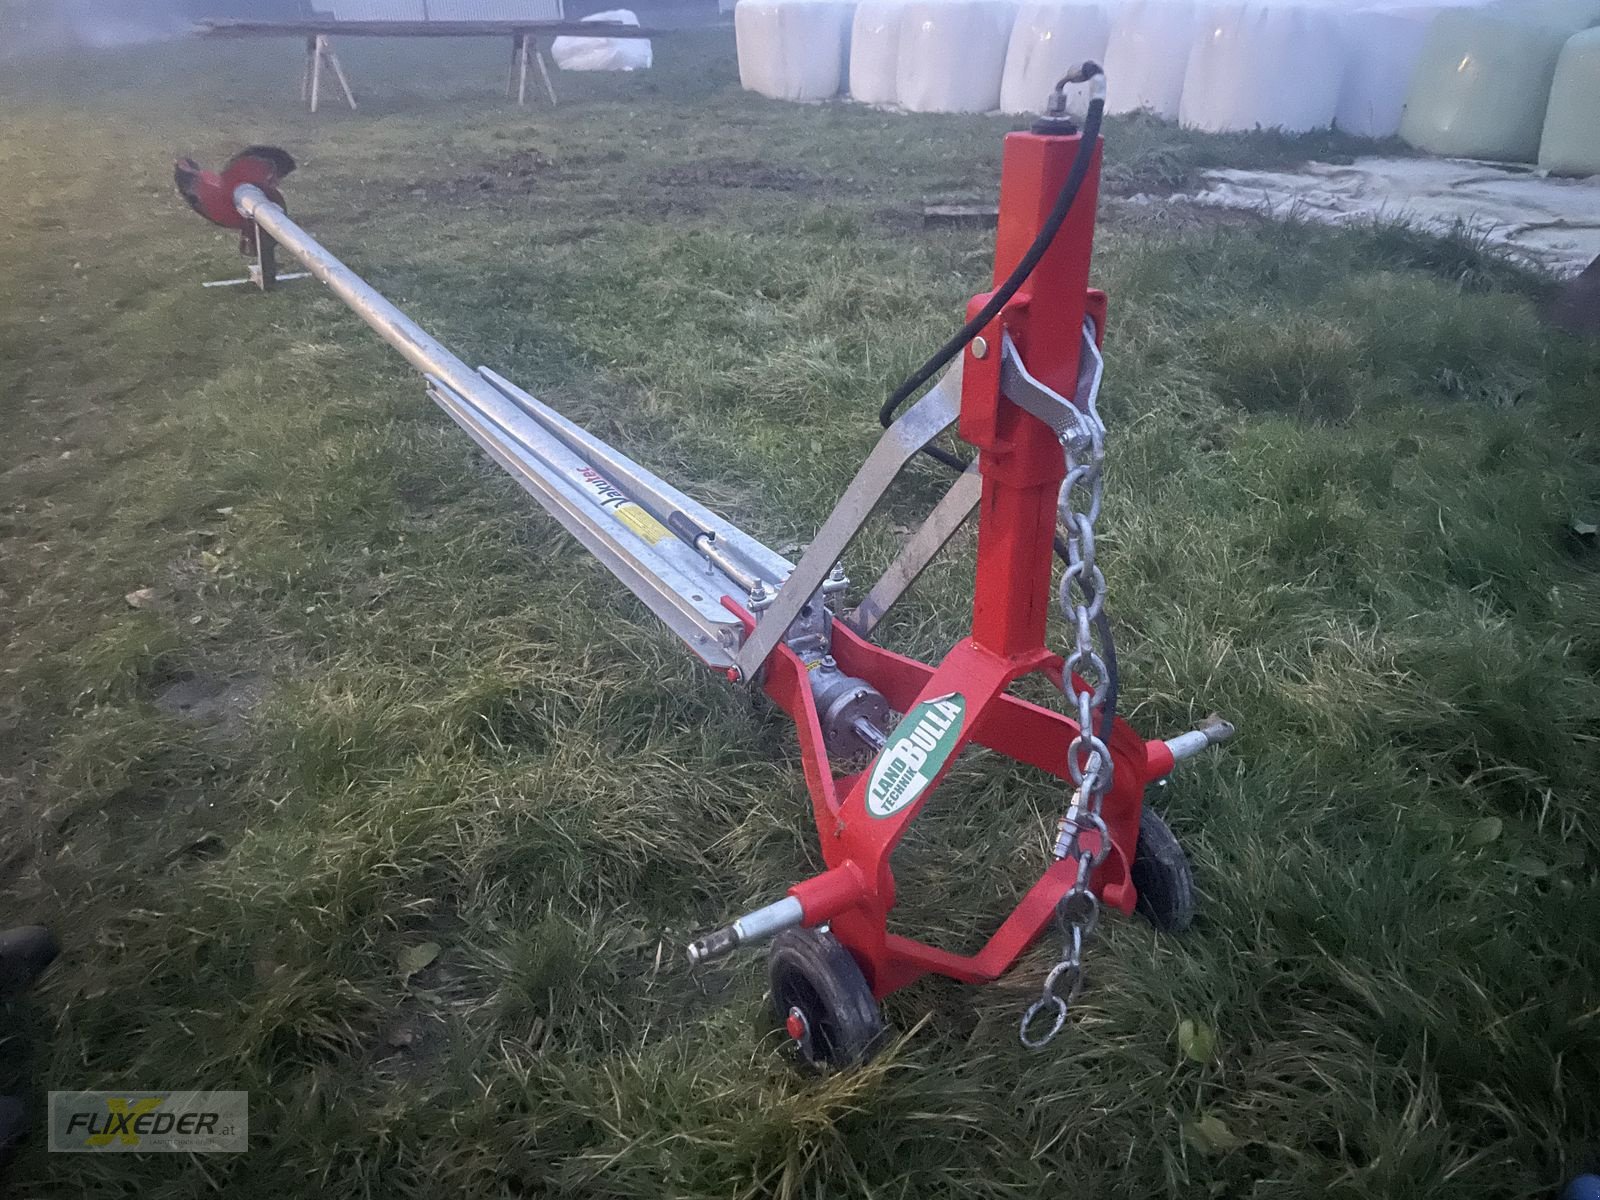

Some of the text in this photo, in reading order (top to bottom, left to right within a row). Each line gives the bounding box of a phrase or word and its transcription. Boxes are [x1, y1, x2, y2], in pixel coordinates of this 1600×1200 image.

[576, 466, 632, 508] Vakutec
[891, 700, 962, 770] BULLA
[872, 757, 907, 801] LAND
[881, 766, 918, 812] TECHNIK
